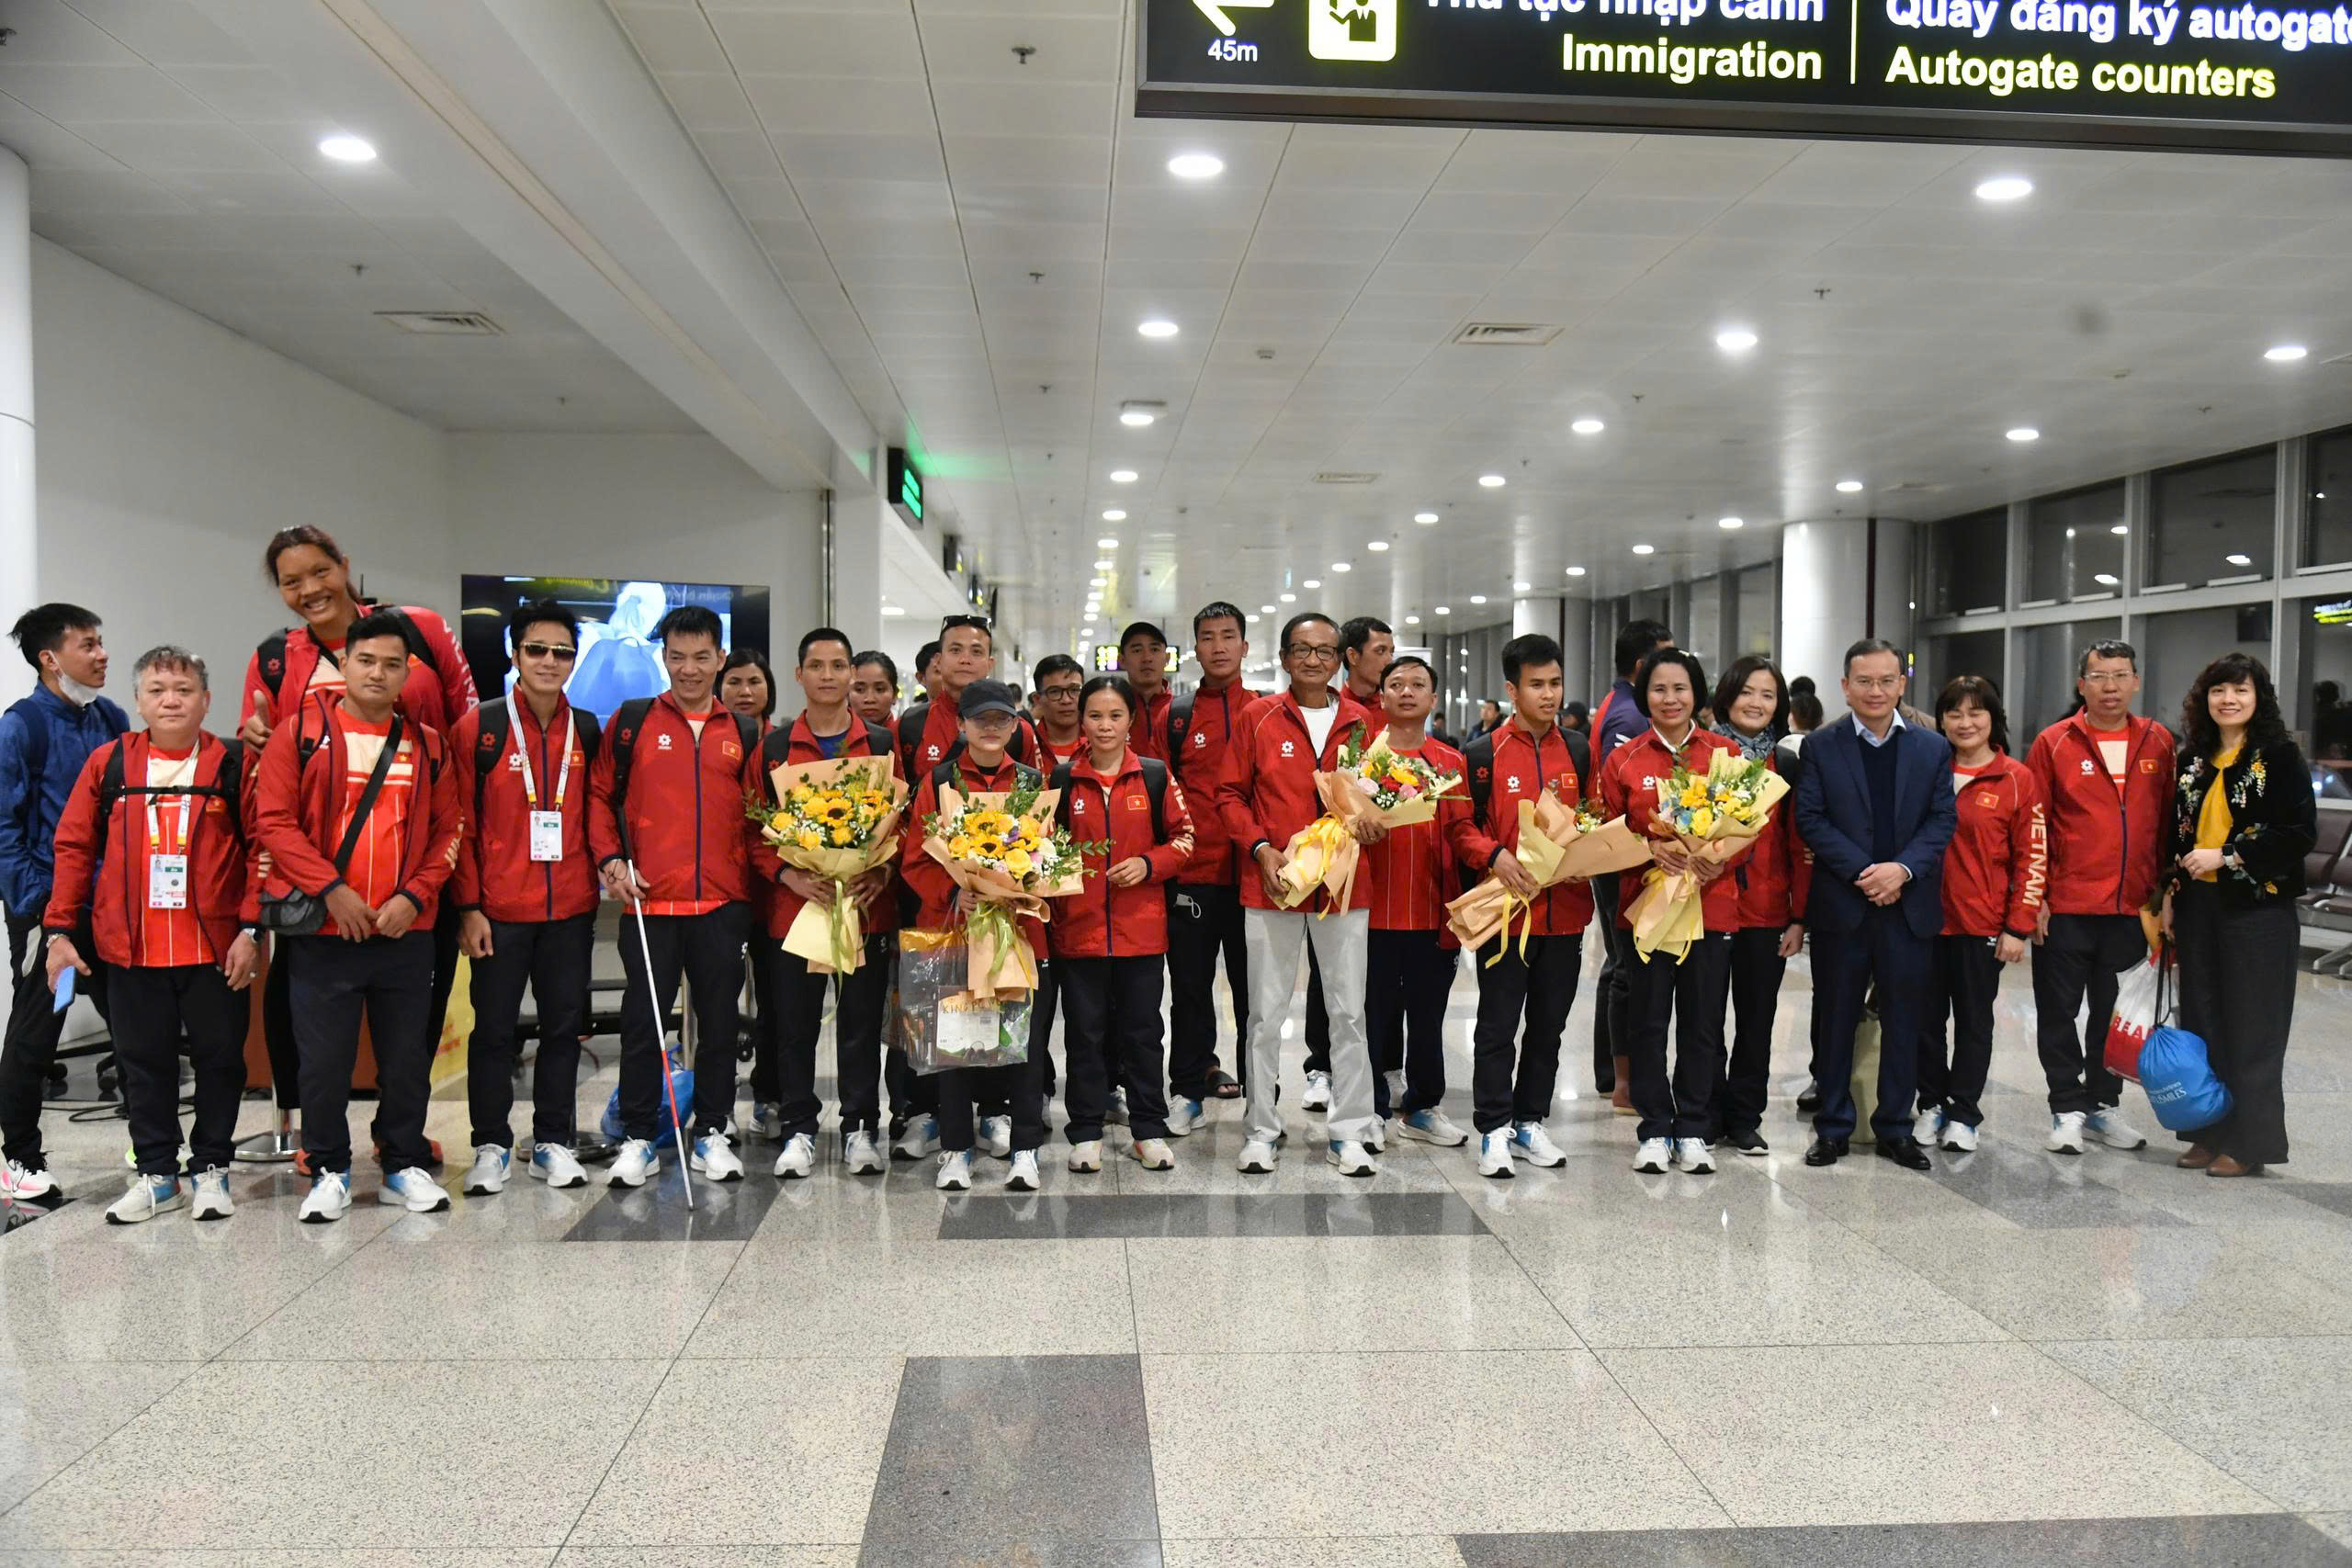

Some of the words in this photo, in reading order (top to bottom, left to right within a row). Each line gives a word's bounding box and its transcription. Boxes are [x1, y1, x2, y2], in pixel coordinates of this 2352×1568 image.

[1208, 39, 1258, 62] 45m
[2129, 0, 2180, 46] ký
[2188, 3, 2352, 51] autogat
[1563, 33, 1822, 85] Immigration
[1884, 46, 2079, 96] Autogate
[2091, 58, 2277, 98] counters
[2022, 802, 2048, 908] VIETNAM
